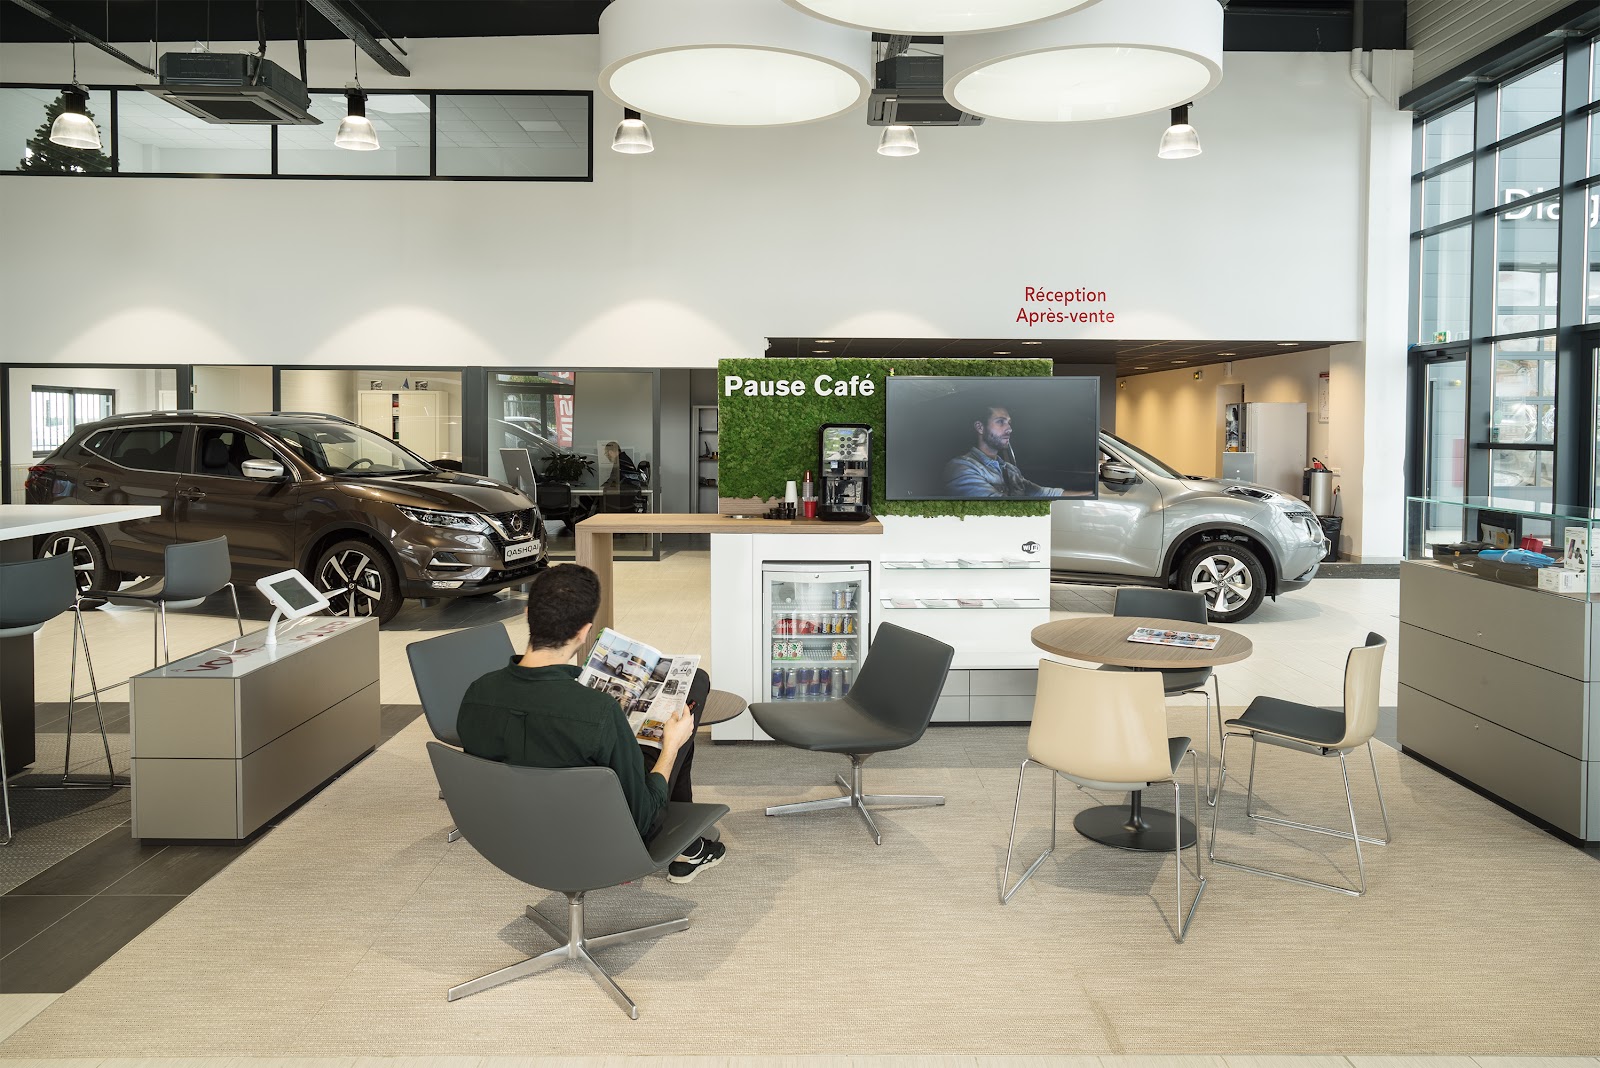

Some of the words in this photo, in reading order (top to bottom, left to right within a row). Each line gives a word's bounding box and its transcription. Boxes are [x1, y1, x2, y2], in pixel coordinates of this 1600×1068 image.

[1025, 286, 1107, 306] Réception
[1016, 307, 1115, 327] Après-vente
[724, 375, 806, 397] Pause
[814, 373, 875, 397] Café
[506, 544, 539, 557] QASHQAI
